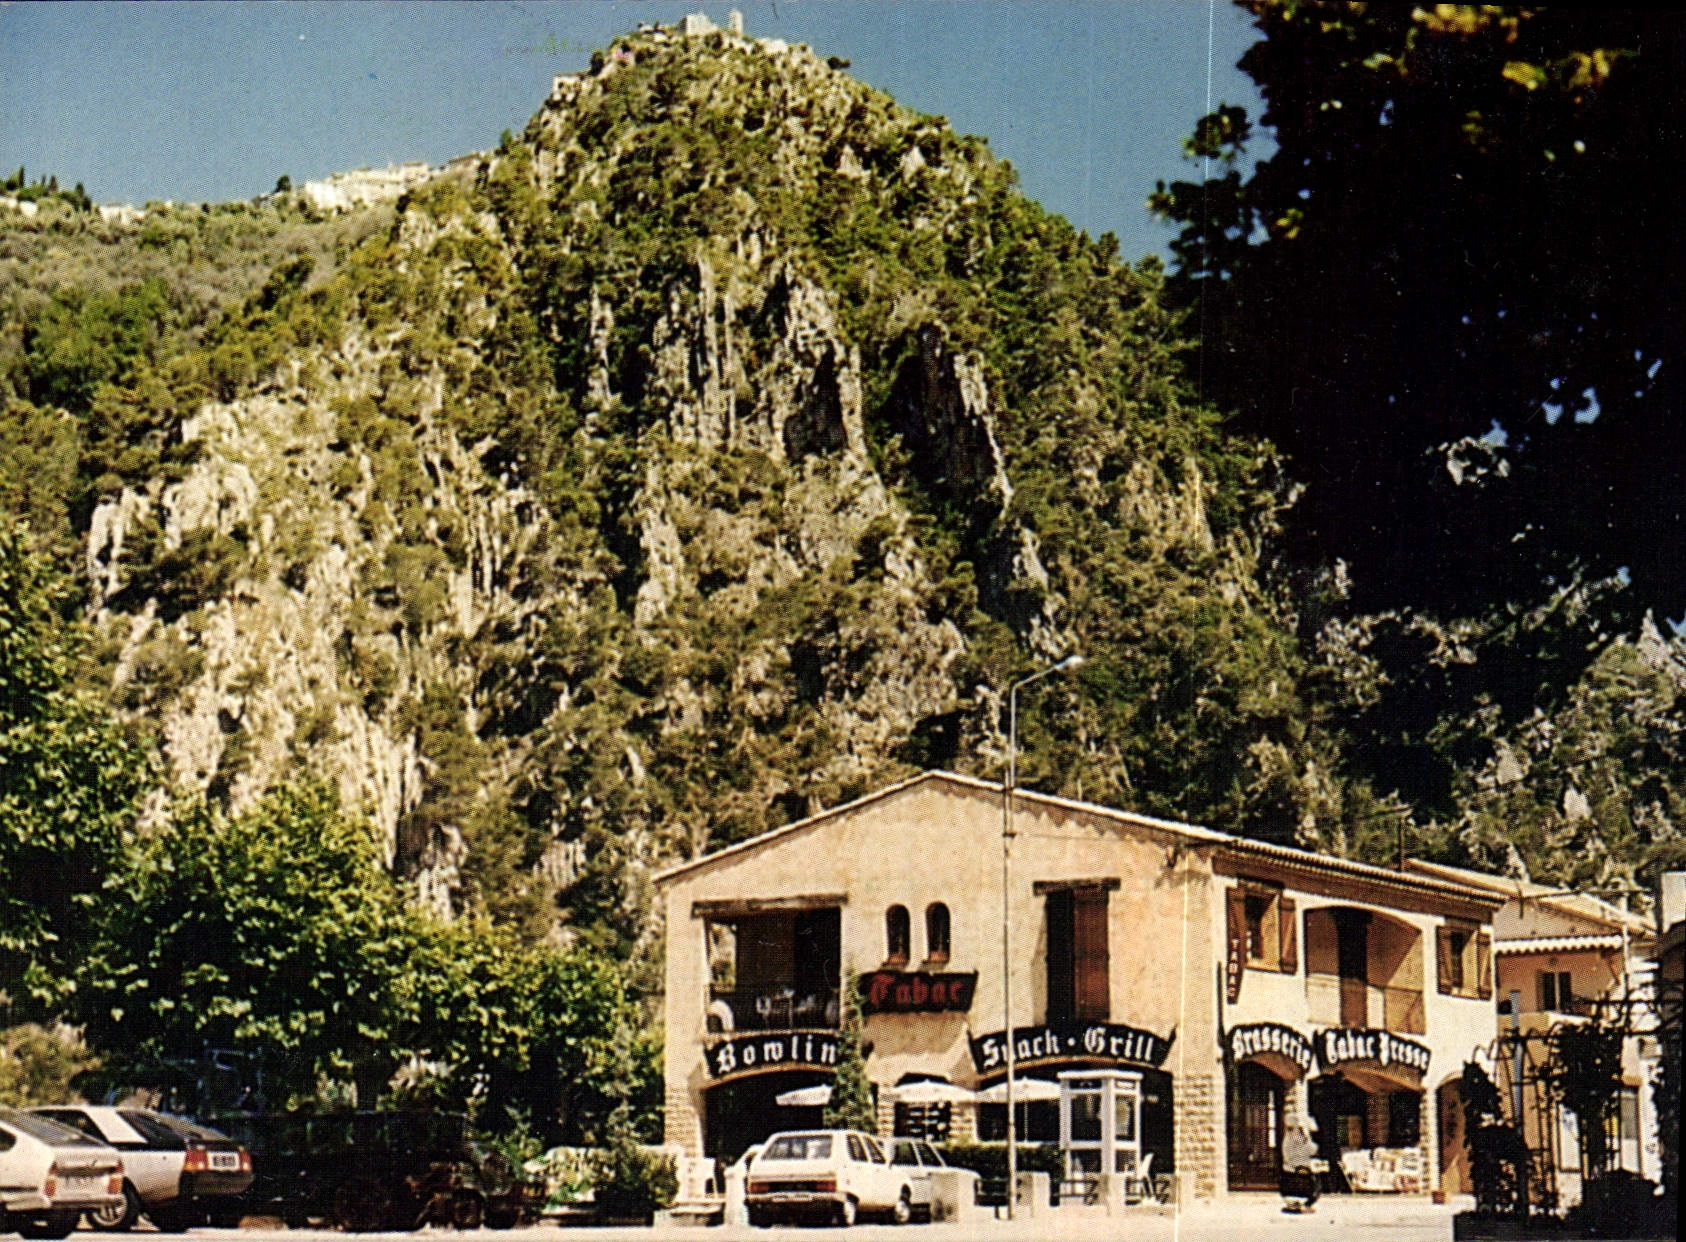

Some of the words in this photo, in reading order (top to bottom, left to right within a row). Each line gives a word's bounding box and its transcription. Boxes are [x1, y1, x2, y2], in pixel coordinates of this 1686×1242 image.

[869, 974, 964, 1007] Tabac
[717, 1034, 836, 1073] Bowlin
[982, 1029, 1060, 1067] Snack
[1084, 1027, 1153, 1060] Grill
[1233, 1027, 1310, 1069] Brasserie
[1326, 1030, 1375, 1064] Tabac
[1379, 1032, 1428, 1069] Presse
